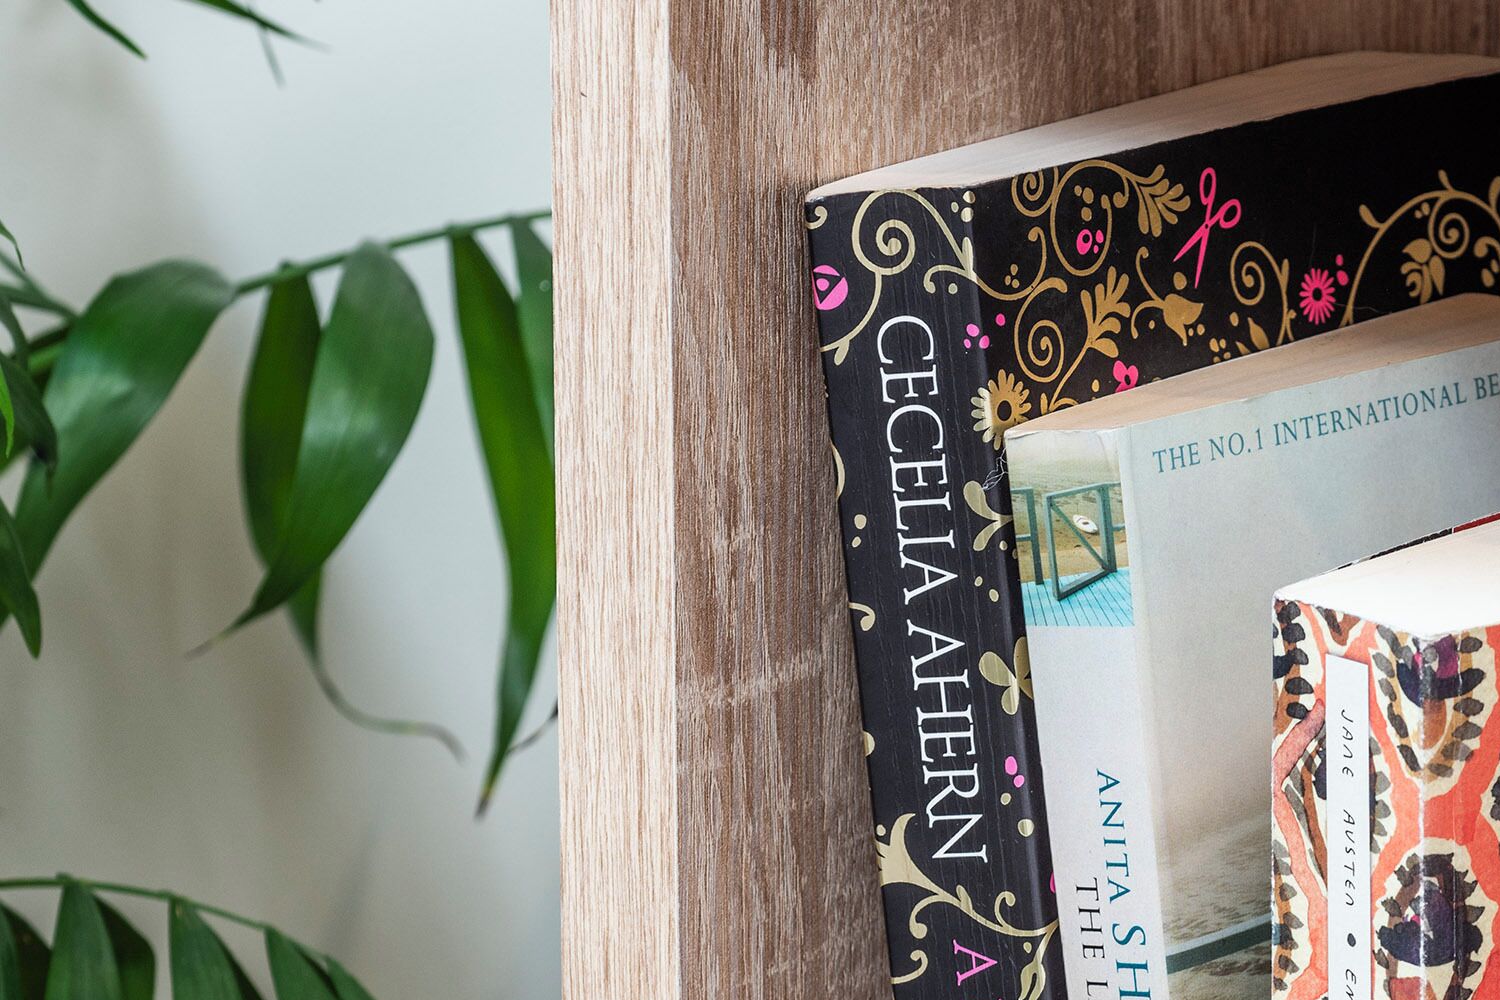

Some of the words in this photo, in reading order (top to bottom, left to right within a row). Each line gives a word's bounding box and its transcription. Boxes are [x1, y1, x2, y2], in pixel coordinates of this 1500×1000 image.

[876, 315, 958, 605] CECELIA
[1153, 442, 1200, 473] THE
[1208, 428, 1264, 461] NO.1
[1273, 382, 1467, 446] INTERNATIONAL
[907, 619, 989, 863] AHERN
[1340, 709, 1356, 777] JANE
[1096, 768, 1131, 903] ANITA
[1343, 809, 1357, 906] AUSTEN
[952, 939, 998, 986] A
[1075, 878, 1104, 971] THE
